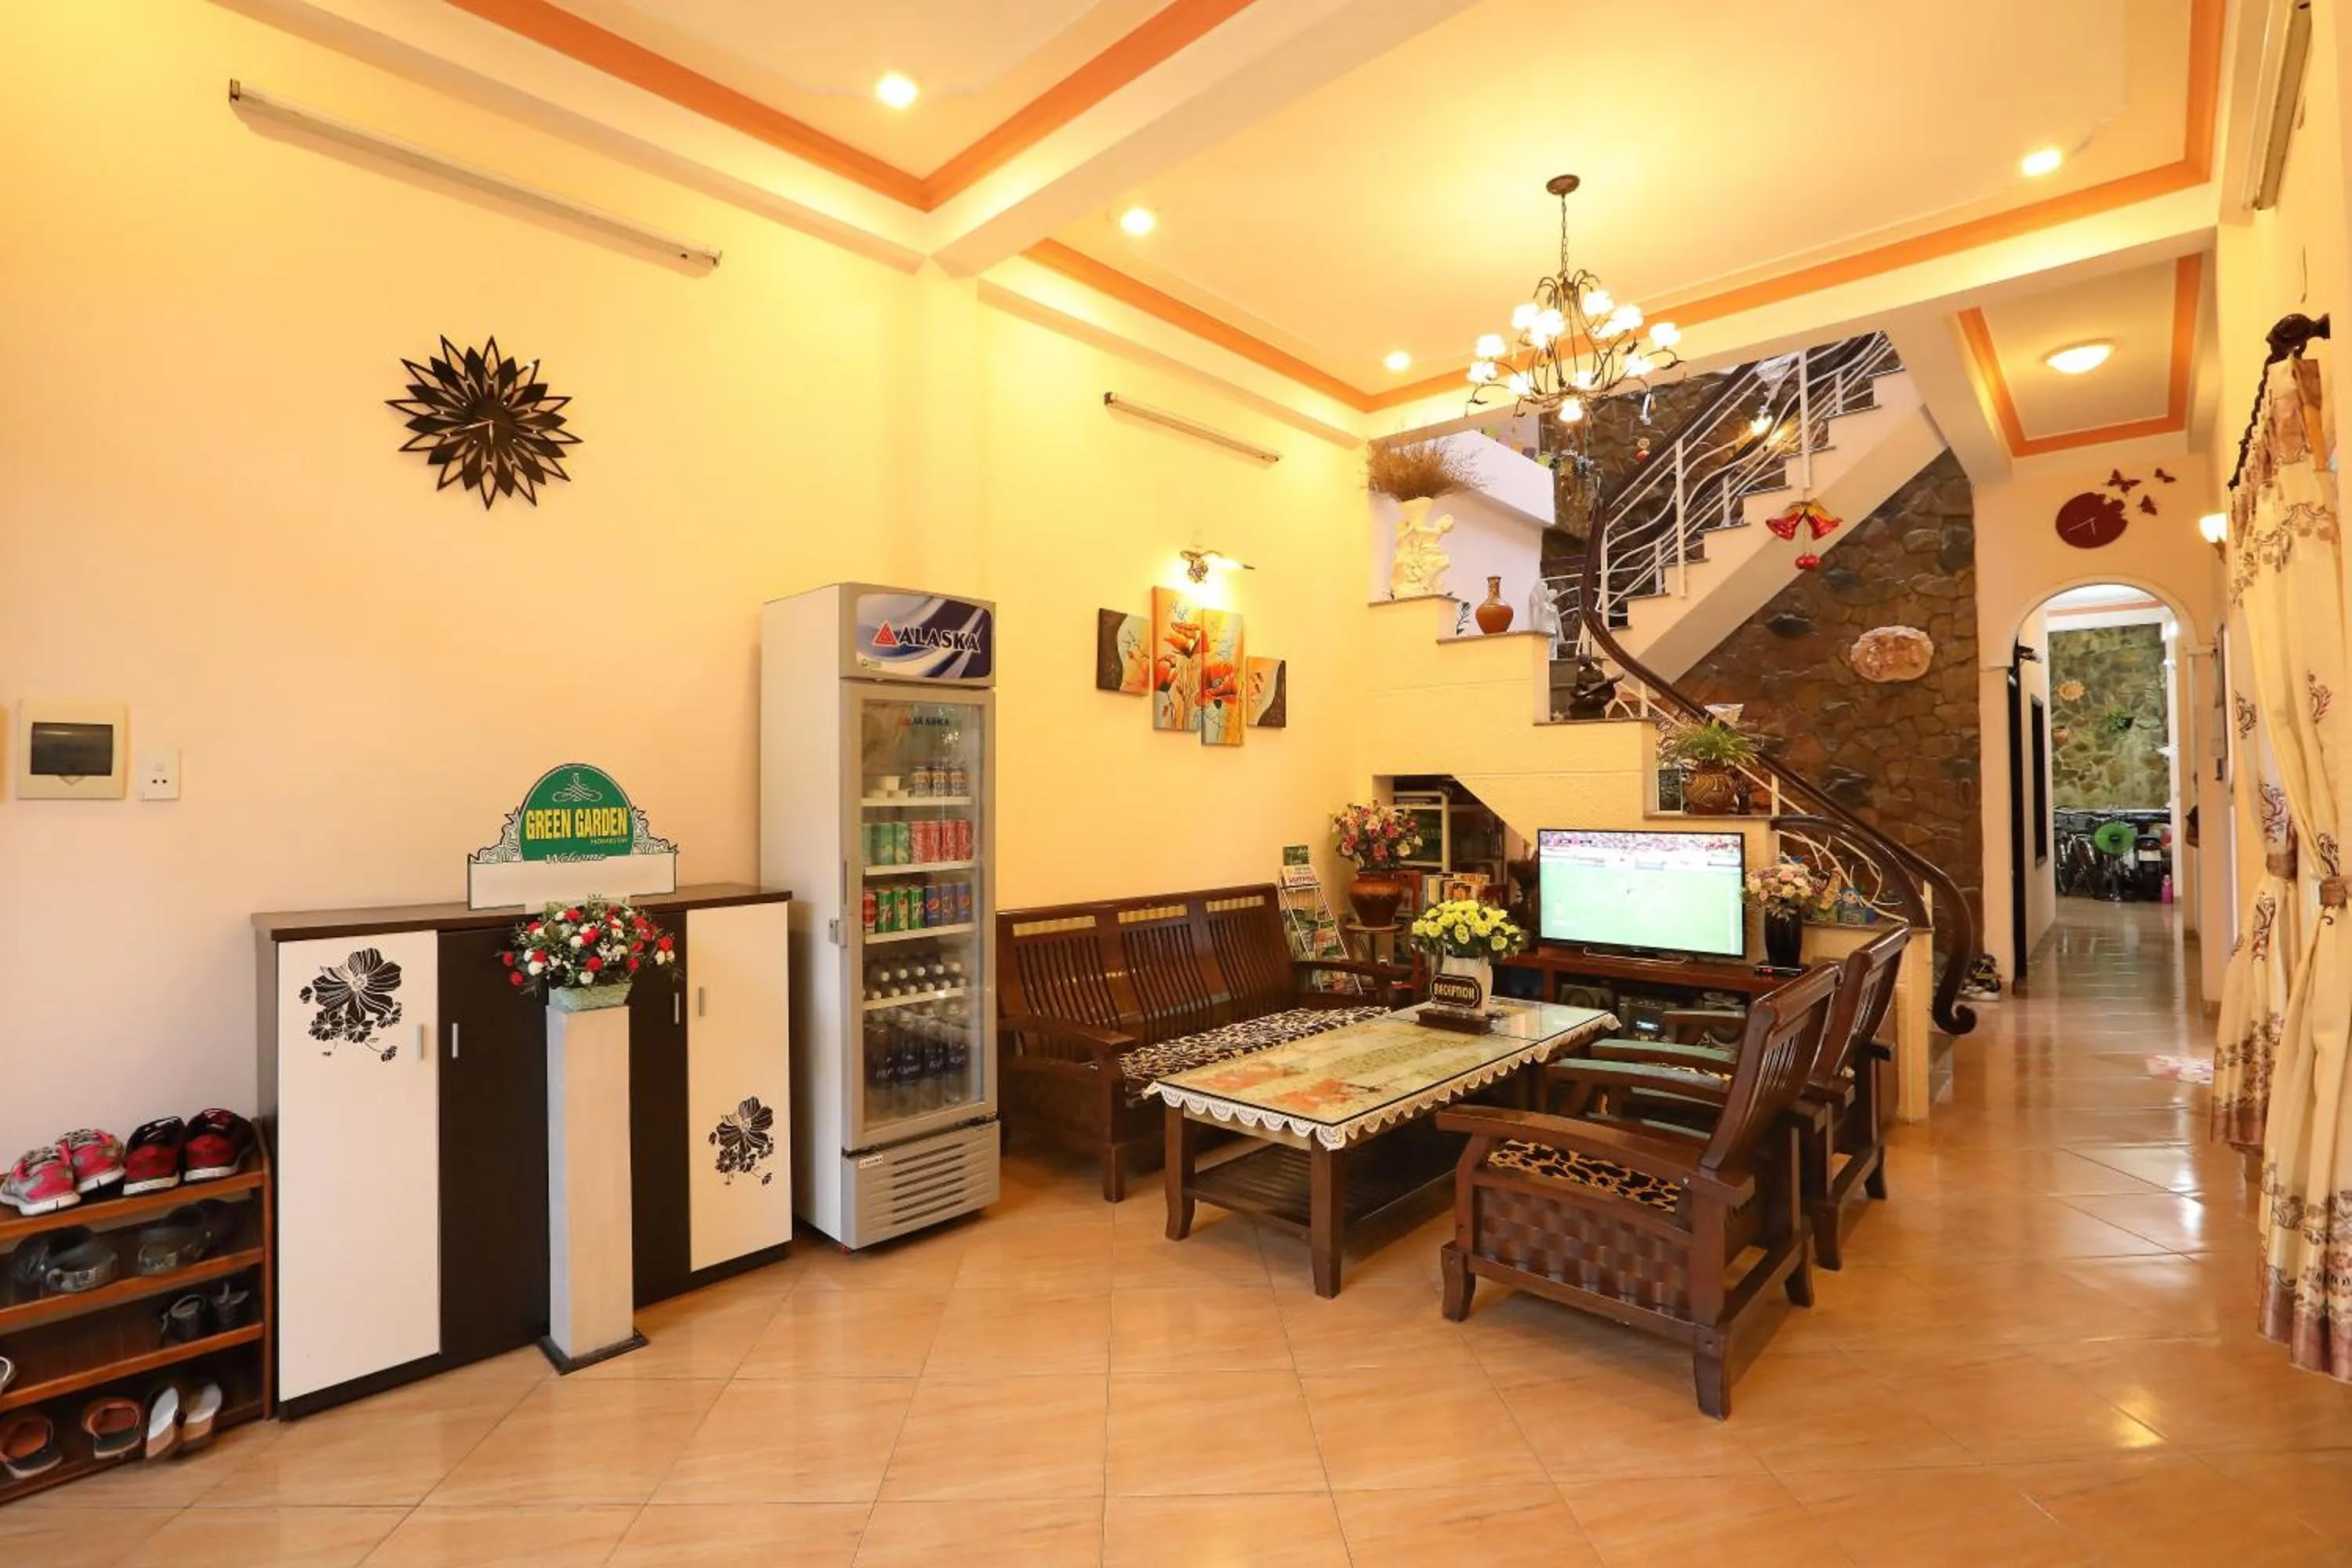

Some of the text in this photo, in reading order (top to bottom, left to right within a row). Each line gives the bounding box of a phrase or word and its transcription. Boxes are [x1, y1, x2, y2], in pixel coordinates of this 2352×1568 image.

[899, 626, 981, 652] ALASKA
[526, 807, 627, 840] GREEN GARDEN
[1434, 982, 1475, 1000] RECEPTION
